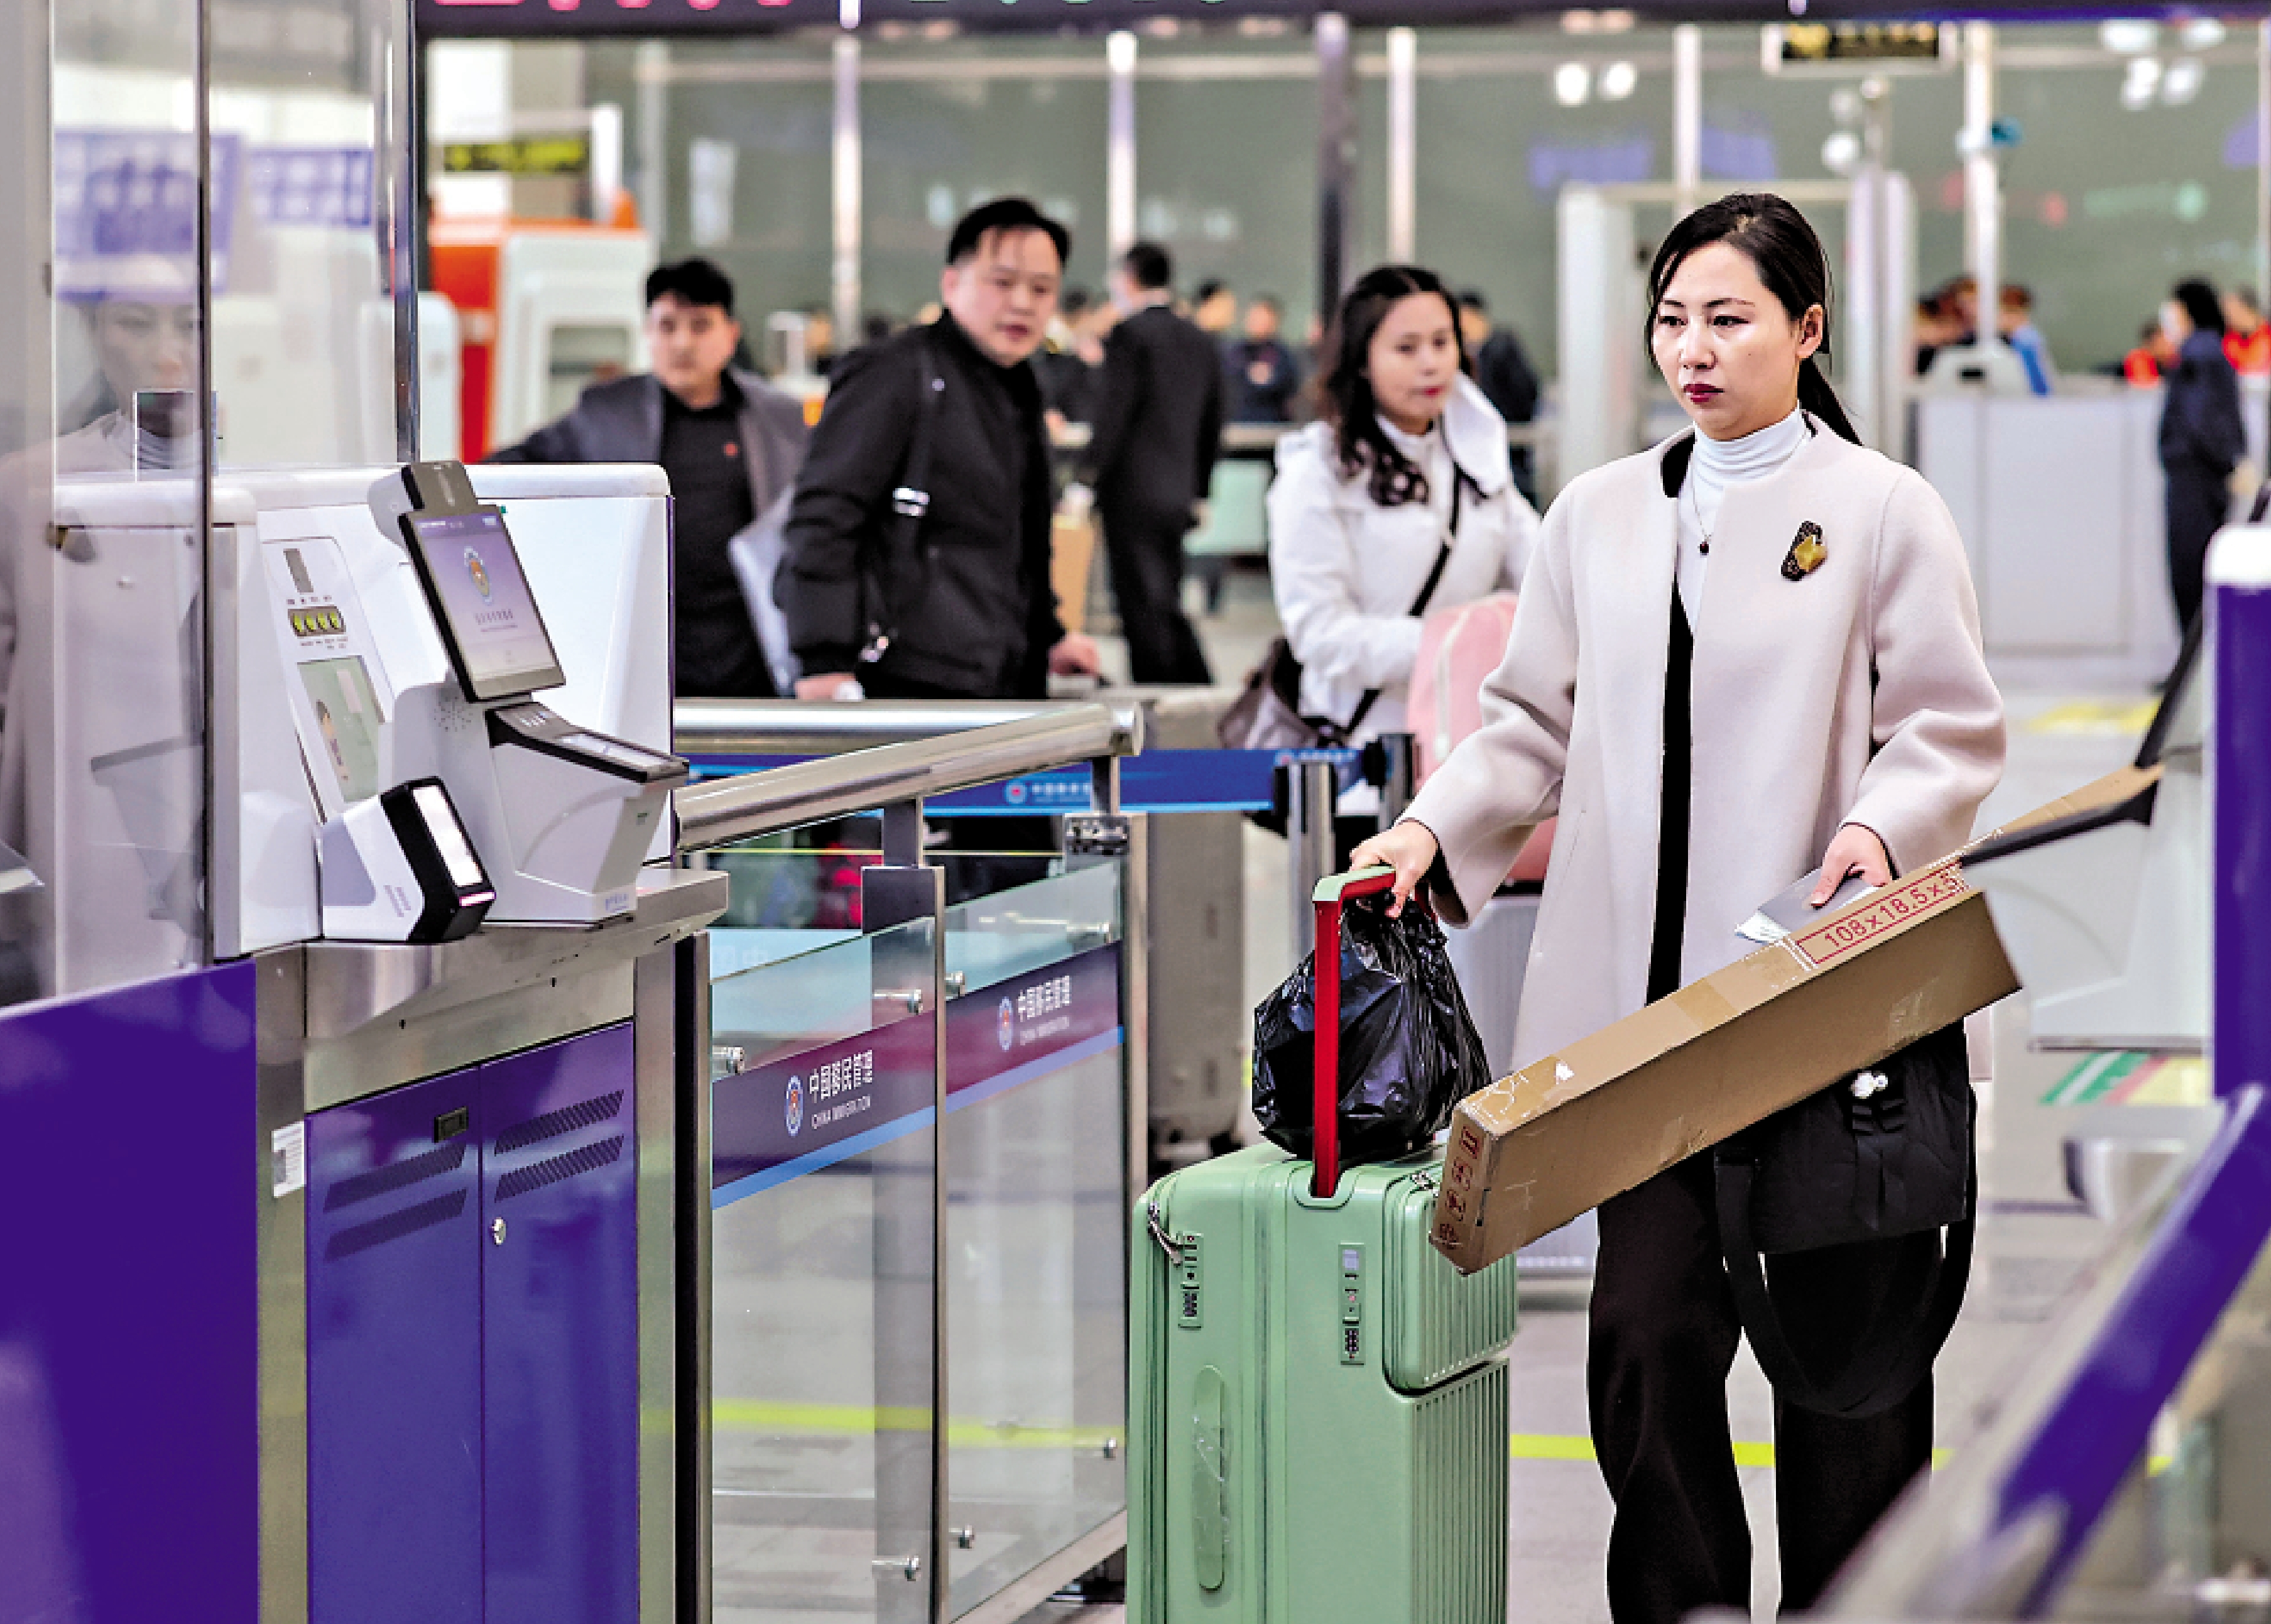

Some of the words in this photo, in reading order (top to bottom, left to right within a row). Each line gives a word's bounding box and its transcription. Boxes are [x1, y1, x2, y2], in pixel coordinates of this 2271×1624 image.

[809, 1049, 873, 1104] 中国移民管理
